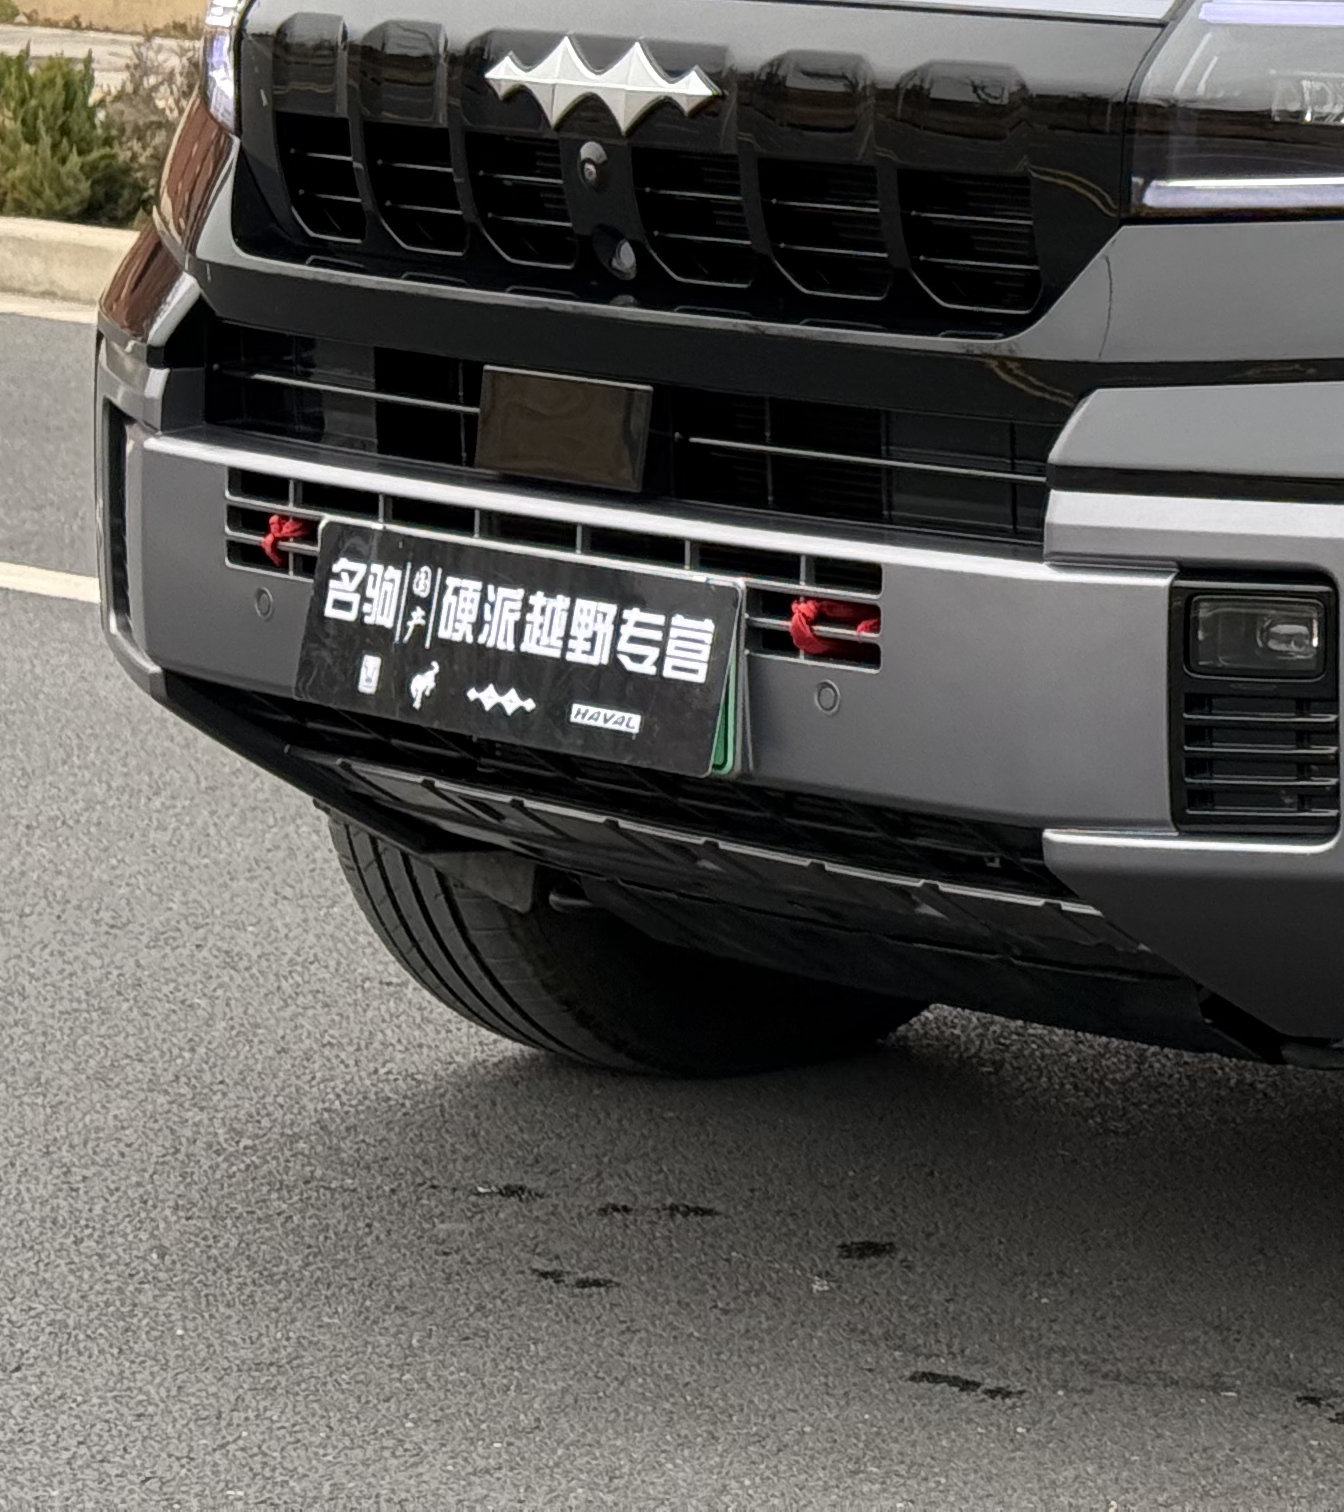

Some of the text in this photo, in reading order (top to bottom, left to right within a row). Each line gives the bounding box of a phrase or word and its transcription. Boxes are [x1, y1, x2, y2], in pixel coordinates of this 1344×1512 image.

[324, 557, 402, 629] 名驹
[438, 575, 715, 684] 硬派越野专营
[573, 707, 637, 730] HAVAL
